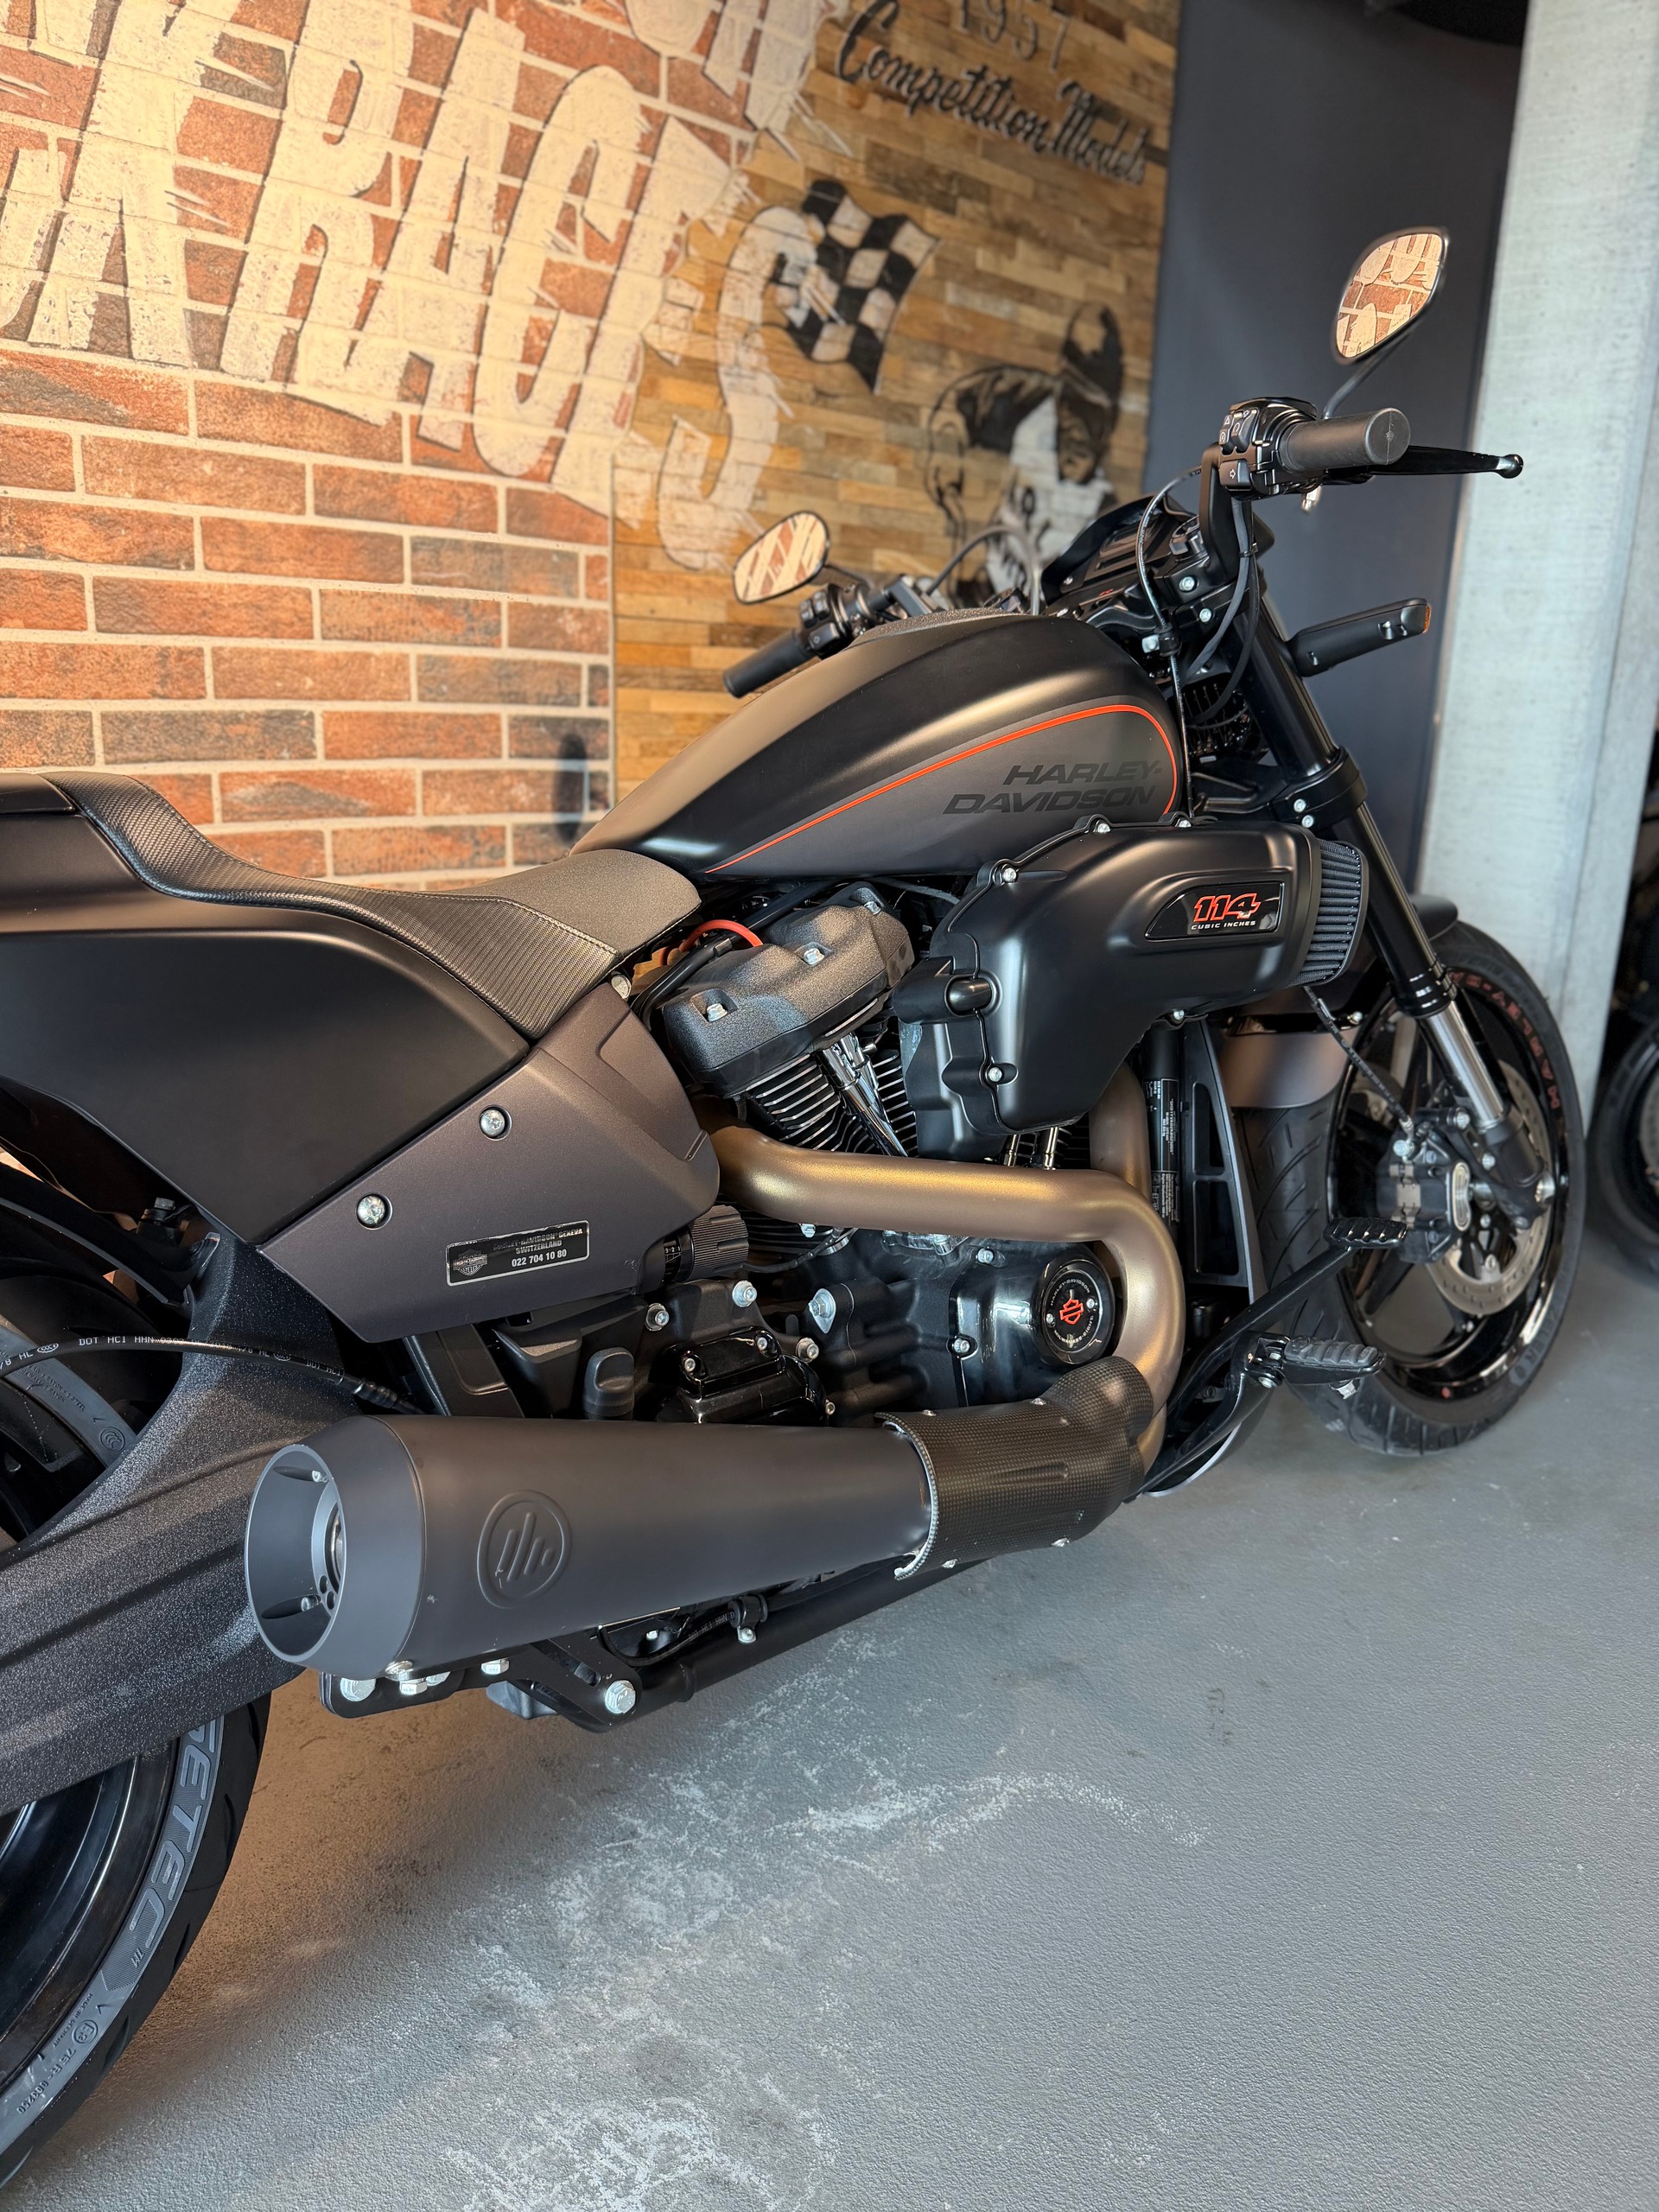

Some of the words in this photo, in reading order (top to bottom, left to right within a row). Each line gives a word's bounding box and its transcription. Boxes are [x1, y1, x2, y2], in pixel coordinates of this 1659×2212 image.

[835, 0, 1050, 156] Competition
[1002, 760, 1163, 786] HARLEY-
[943, 785, 1156, 815] DAVIDSON
[1193, 893, 1262, 922] 114
[512, 1256, 527, 1268] 022
[528, 1254, 543, 1264] 704
[545, 1251, 556, 1262] 10
[556, 1249, 568, 1258] 80
[515, 1239, 563, 1255] SWITZERLAND
[1051, 1278, 1090, 1306] HARLEY-DAVIDSON
[19, 1351, 34, 1360] HL
[79, 1337, 99, 1346] DOT
